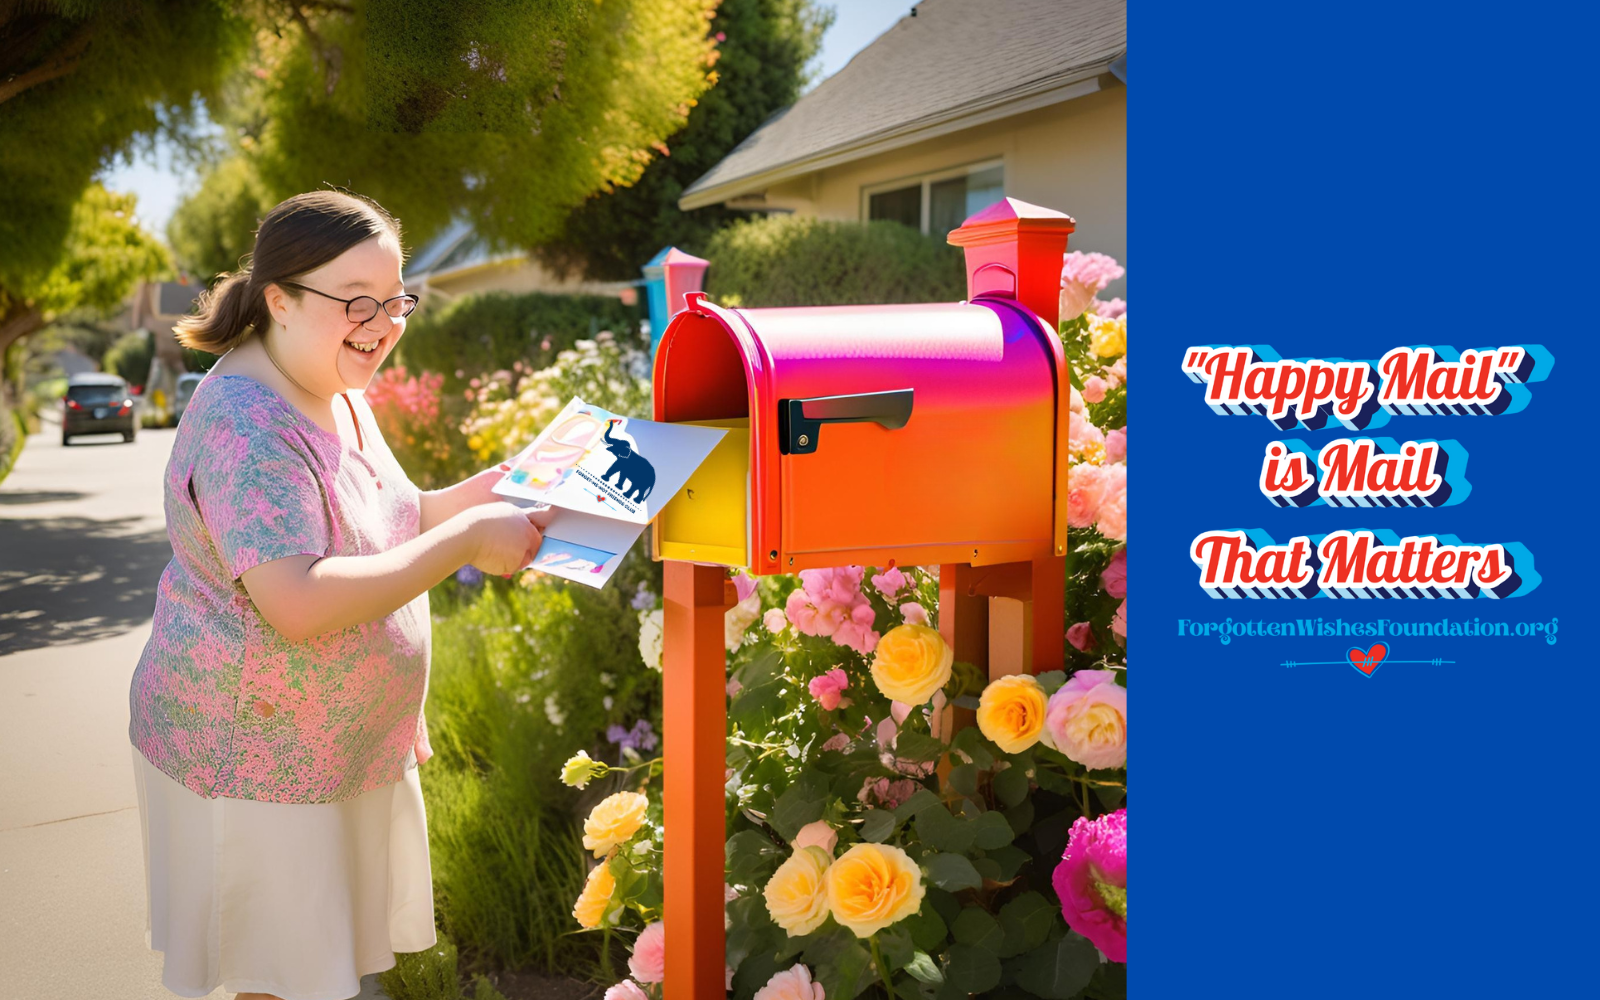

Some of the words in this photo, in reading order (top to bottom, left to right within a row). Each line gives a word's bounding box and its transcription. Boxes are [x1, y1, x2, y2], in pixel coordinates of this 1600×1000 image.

[576, 469, 608, 494] FORGET-ME-NOT
[607, 492, 625, 507] FRIENDS
[624, 504, 636, 514] CLUB
